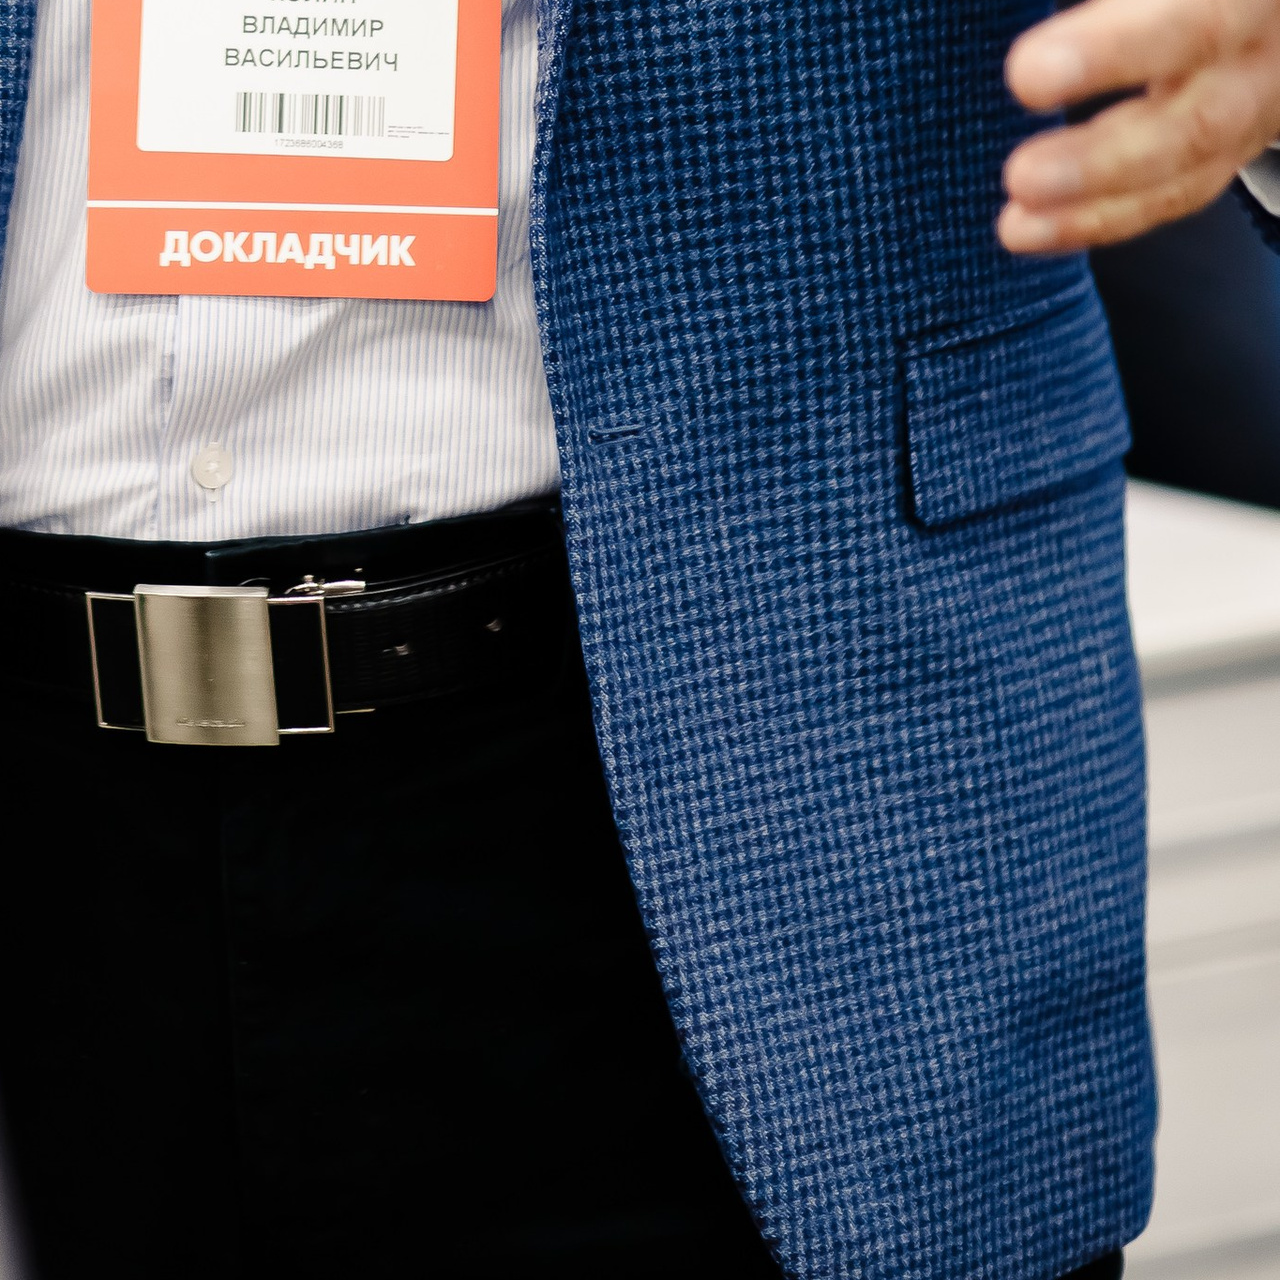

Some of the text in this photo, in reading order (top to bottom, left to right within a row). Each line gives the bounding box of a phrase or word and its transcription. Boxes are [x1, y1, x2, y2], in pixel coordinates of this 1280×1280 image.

[242, 15, 384, 38] ВЛАДИМИР
[224, 48, 399, 72] ВАСИЛЬЕВИЧ
[159, 230, 417, 270] ДОКЛАДЧИК
